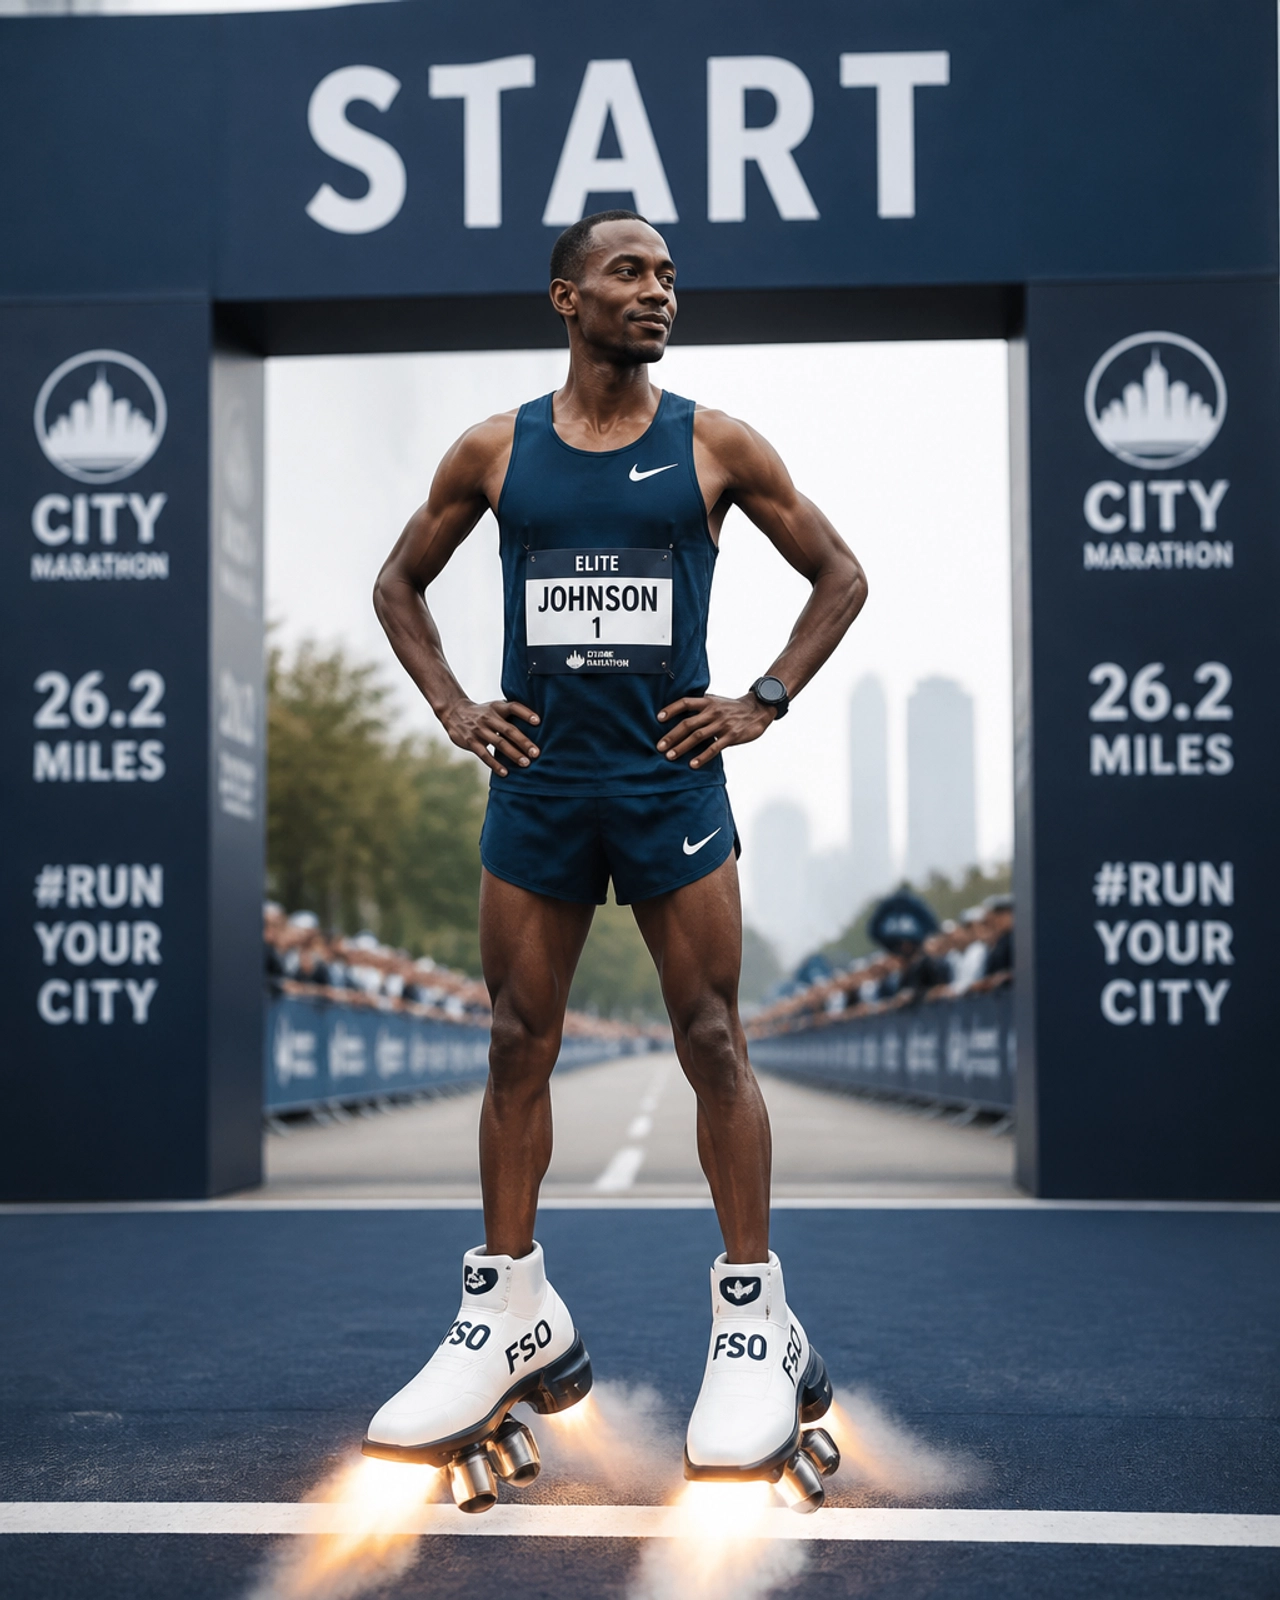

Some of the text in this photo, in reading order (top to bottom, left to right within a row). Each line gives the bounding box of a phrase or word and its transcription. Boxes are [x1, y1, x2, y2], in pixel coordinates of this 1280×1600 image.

[306, 50, 951, 235] START
[32, 492, 167, 546] CITY
[1083, 479, 1229, 535] CITY
[31, 551, 169, 581] MARATHON
[575, 555, 620, 572] ELITE
[1082, 541, 1235, 570] MARATHON
[537, 585, 658, 612] JOHNSON
[591, 616, 601, 639] 1
[34, 669, 166, 728] 26.2
[1088, 661, 1233, 722] 26.2
[33, 739, 166, 783] MILES
[1089, 733, 1234, 776] MILES
[34, 863, 164, 908] #RUN
[1093, 862, 1235, 907] #RUN
[34, 920, 162, 965] YOUR
[1095, 919, 1234, 966] YOUR
[37, 977, 158, 1025] CITY
[1100, 979, 1229, 1026] CITY
[504, 1319, 552, 1376] FSO
[713, 1332, 767, 1361] FSO
